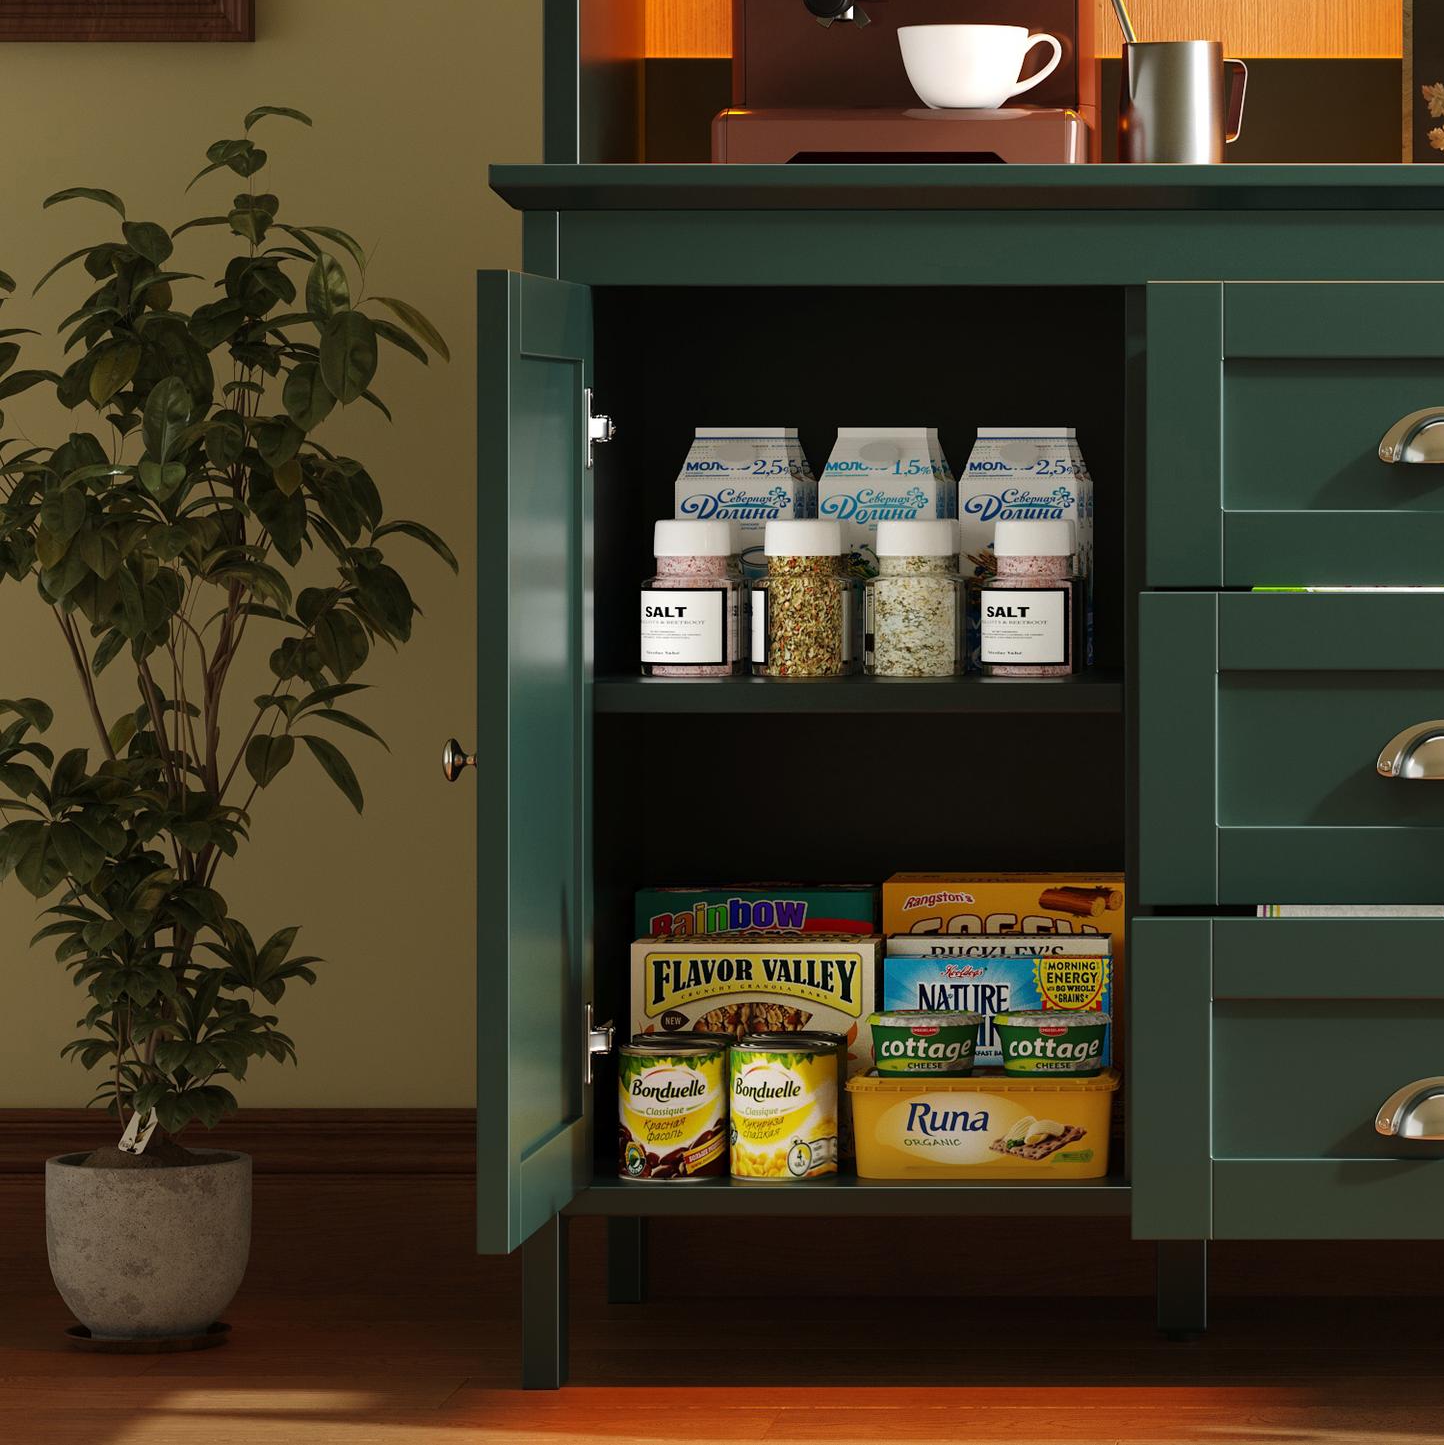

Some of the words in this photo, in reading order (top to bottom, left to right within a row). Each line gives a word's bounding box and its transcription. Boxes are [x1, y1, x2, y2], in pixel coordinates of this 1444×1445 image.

[717, 488, 772, 505] Северная
[856, 488, 910, 505] Северная
[1001, 488, 1056, 505] Северная
[681, 494, 779, 519] Долина
[821, 494, 917, 524] Долина
[964, 494, 1064, 521] Долина
[645, 606, 687, 618] SALT
[987, 606, 1030, 618] SALT
[650, 897, 808, 936] Rainbow
[1047, 961, 1096, 970] MORNING
[652, 959, 752, 1005] FLAVOR
[762, 959, 857, 1003] VALLEY
[1046, 972, 1098, 983] ENERGY
[681, 985, 731, 999] CRUNCHY
[740, 983, 792, 992] GRANOLA
[800, 989, 828, 1000] BARS
[918, 983, 1010, 1015] NATURE
[1058, 993, 1085, 1003] GRAINS
[665, 1016, 682, 1026] NEW
[881, 1037, 972, 1062] cottage
[1009, 1038, 1099, 1062] cottage
[632, 1079, 705, 1103] Bonduelle
[735, 1077, 801, 1103] Bonduelle
[645, 1107, 685, 1117] Classique
[745, 1107, 779, 1117] Classique
[906, 1102, 989, 1137] Runa
[643, 1117, 687, 1132] Красная
[743, 1116, 785, 1131] Кукуруза
[646, 1129, 683, 1144] фасоль
[904, 1138, 961, 1147] ORGANIC
